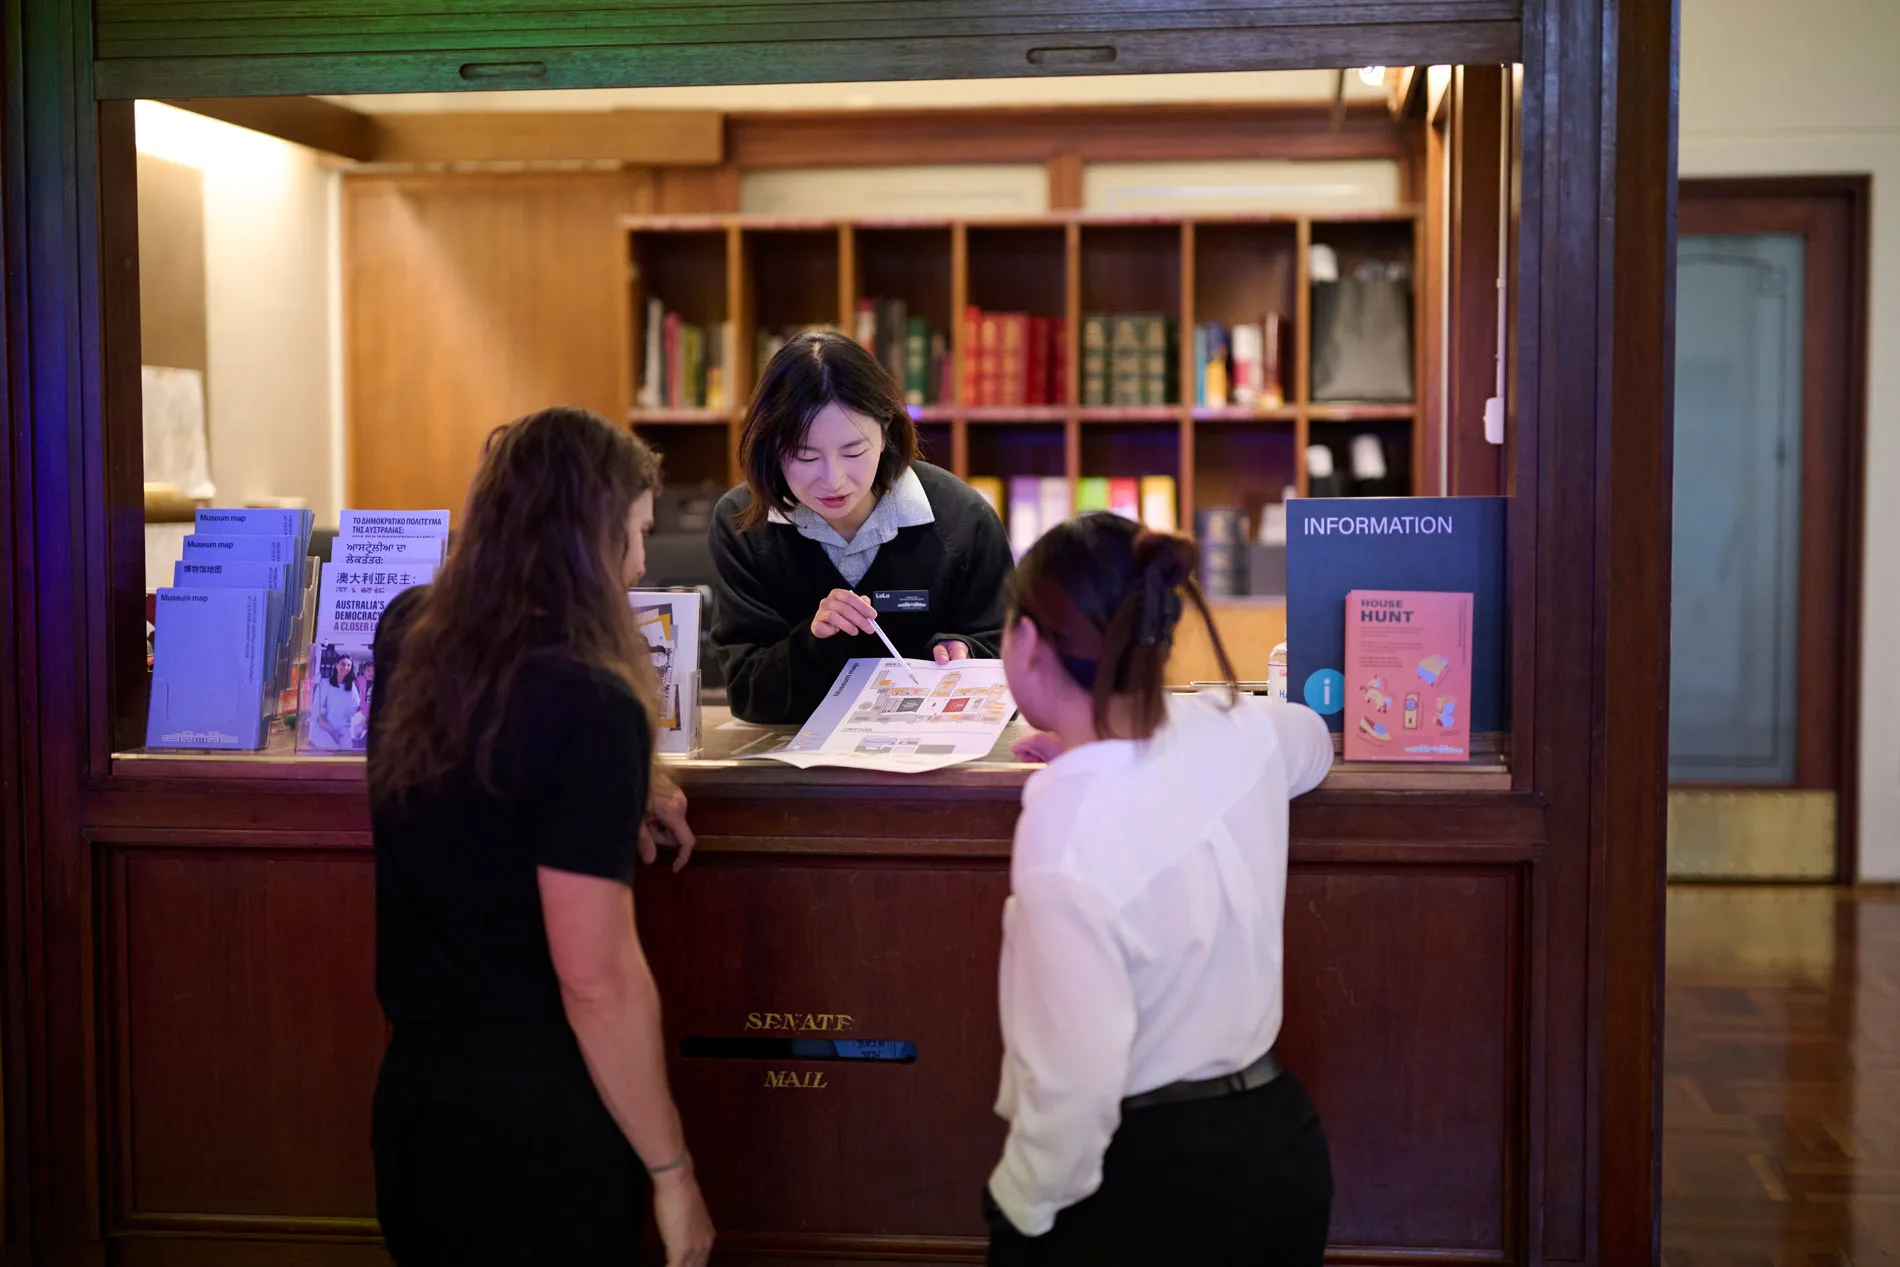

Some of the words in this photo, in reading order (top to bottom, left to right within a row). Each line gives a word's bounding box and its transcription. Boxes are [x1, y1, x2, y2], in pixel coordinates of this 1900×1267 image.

[200, 514, 230, 522] Museum
[230, 515, 247, 524] map
[352, 517, 361, 525] ΤΟ
[362, 517, 406, 526] ΔΗΜΟΚΡΑΤΙΚΟ
[406, 518, 442, 526] ΠΟΛΙΤΕΥΜΑ
[352, 526, 364, 534] ΤΗΣ
[365, 526, 405, 535] ΑΥΣΤΡΑΛΙΑΣ:
[1303, 516, 1453, 536] INFORMATION
[187, 540, 217, 548] Museum
[218, 542, 234, 550] map
[160, 593, 191, 602] Museum
[192, 595, 208, 604] map
[1360, 599, 1404, 609] HOUSE
[335, 600, 385, 610] AUSTRALIA'S
[1359, 610, 1415, 623] HUNT
[333, 622, 339, 631] A
[340, 621, 369, 632] CLOSER
[832, 674, 852, 697] Museum
[848, 662, 860, 675] map
[744, 1012, 855, 1031] SENATE
[764, 1070, 828, 1089] MAIL
